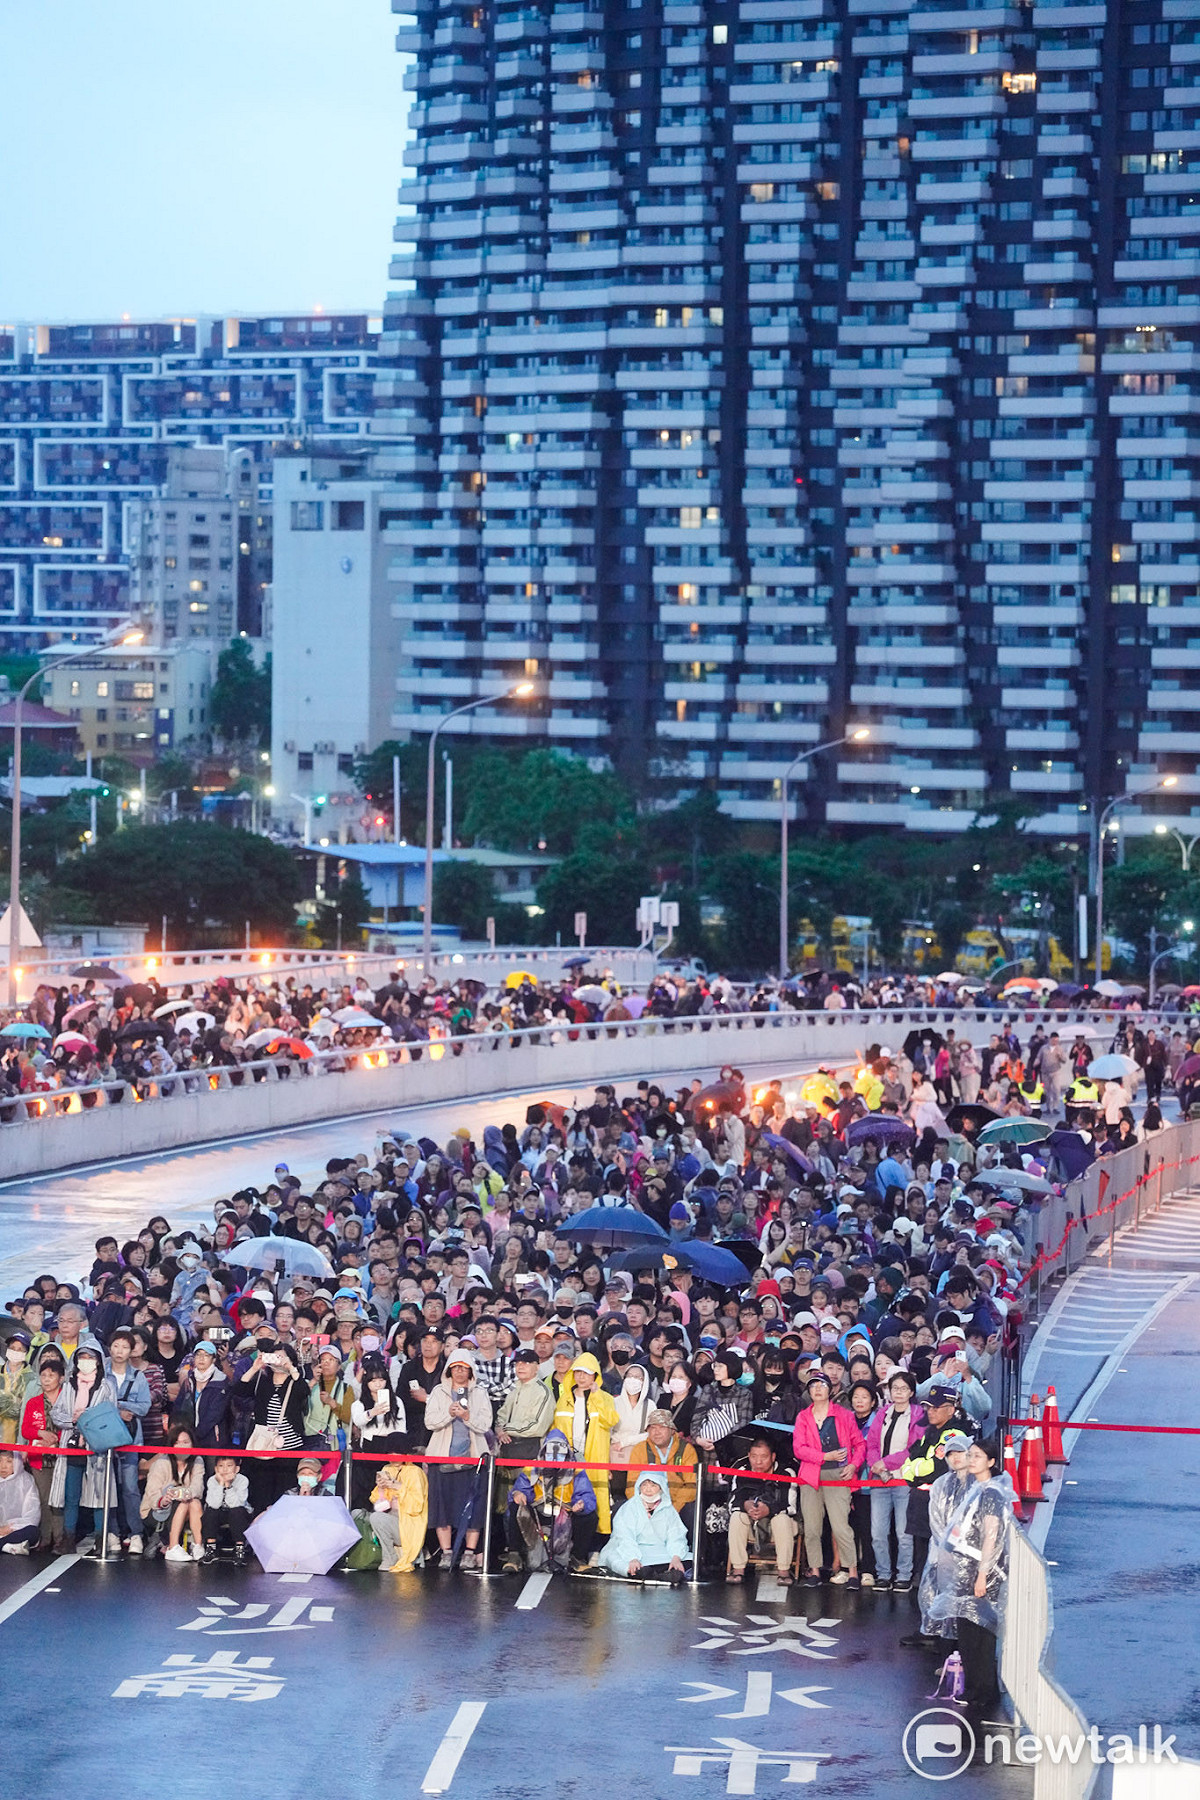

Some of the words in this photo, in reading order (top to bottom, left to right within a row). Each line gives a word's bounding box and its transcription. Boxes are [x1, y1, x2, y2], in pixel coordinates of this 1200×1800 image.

[111, 1596, 335, 1702] 沙崙
[664, 1614, 843, 1795] 淡水市
